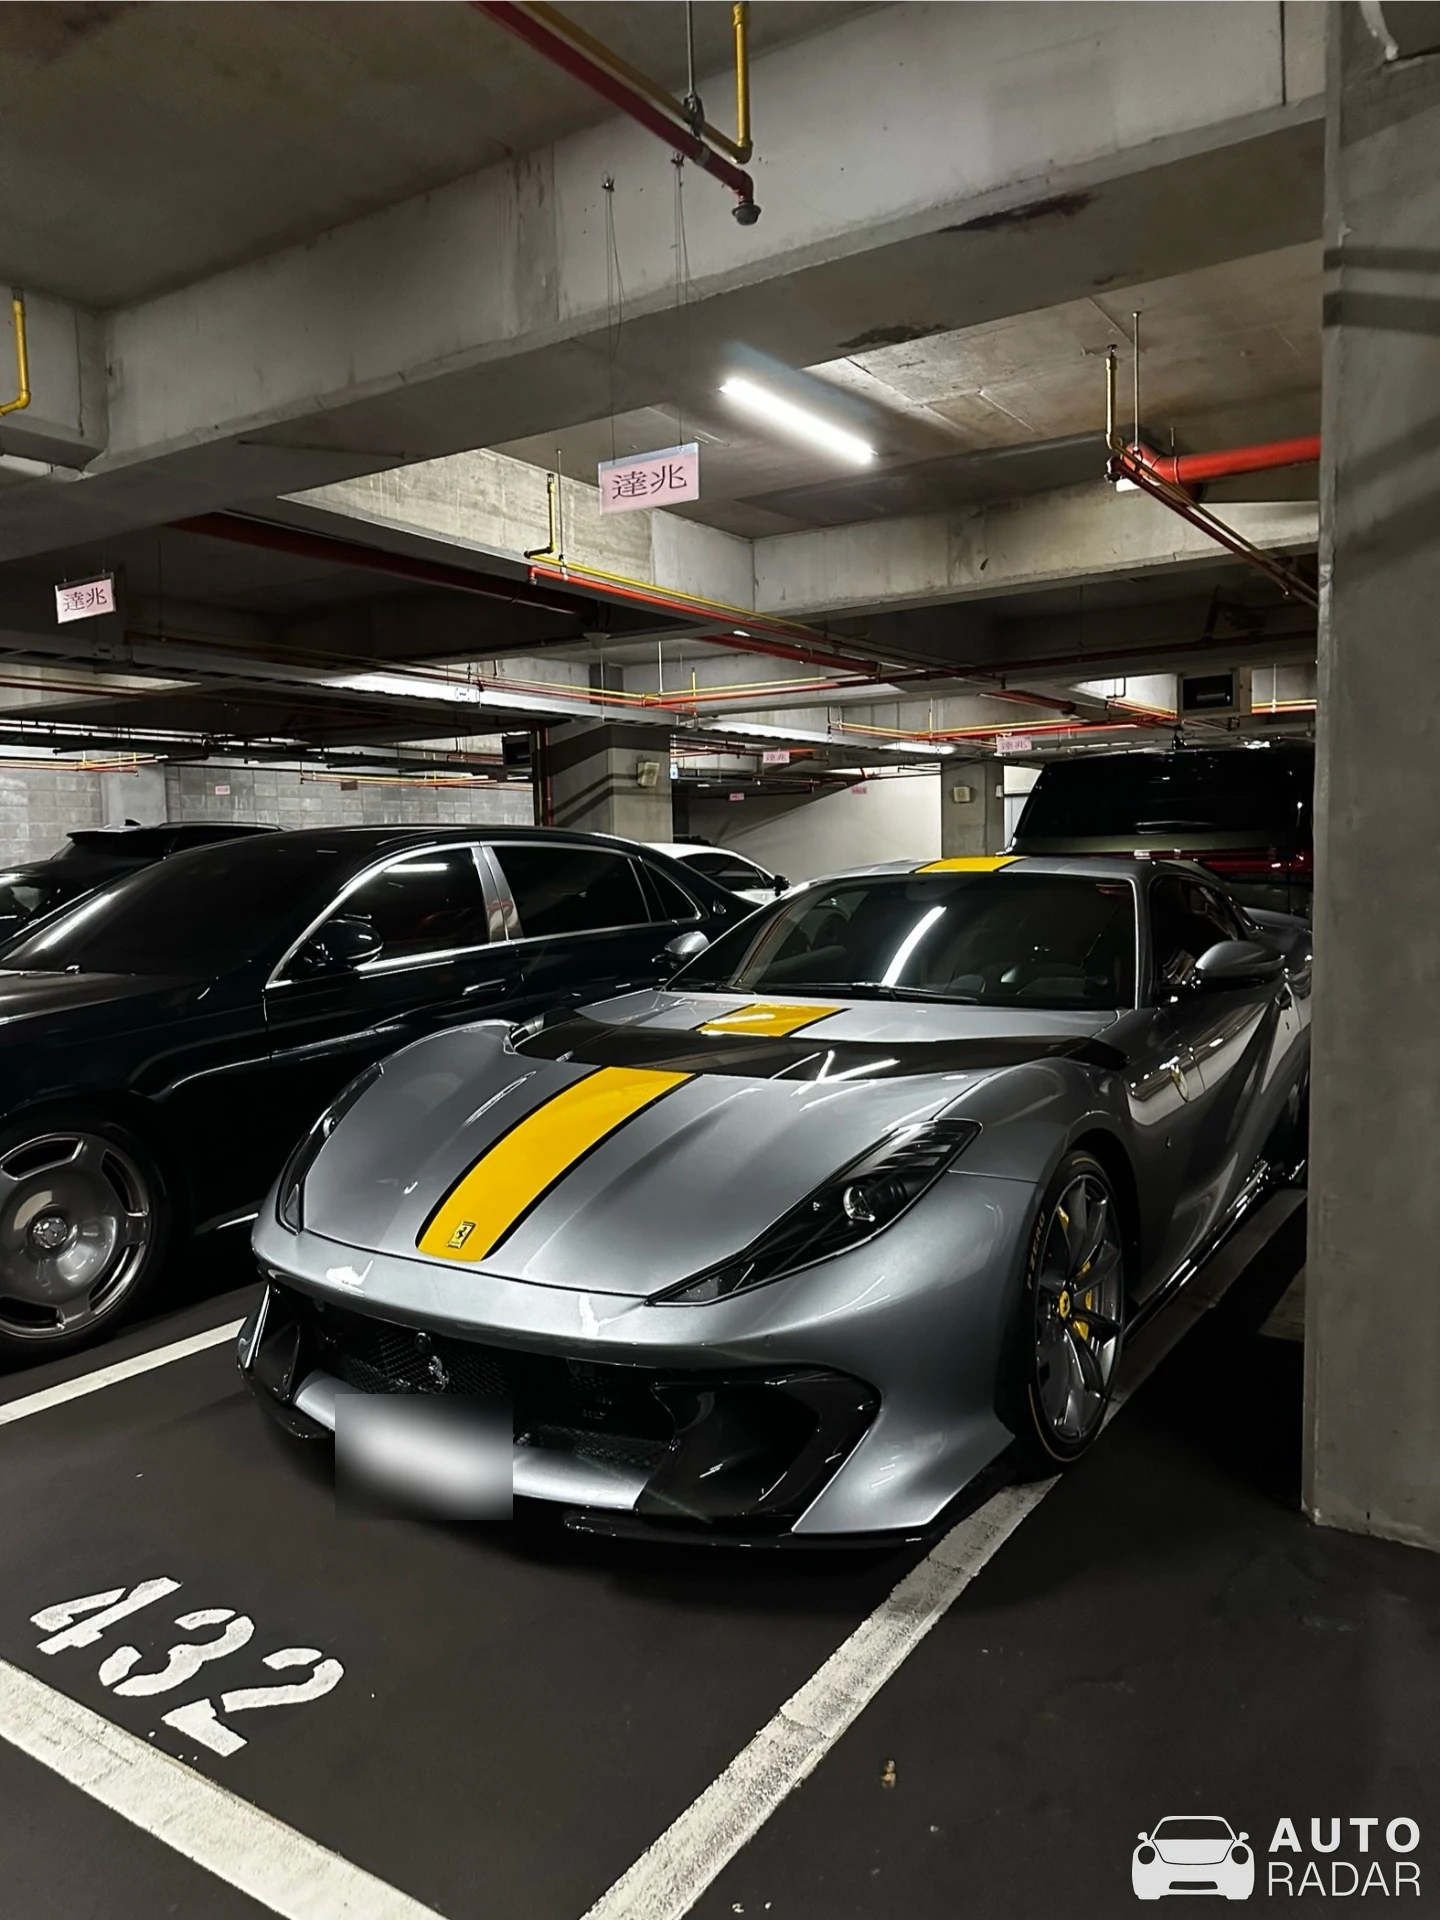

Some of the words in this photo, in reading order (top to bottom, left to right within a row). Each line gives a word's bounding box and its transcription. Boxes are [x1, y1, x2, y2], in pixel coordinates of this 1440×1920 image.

[612, 464, 687, 500] 達兆
[62, 587, 108, 612] 達兆
[30, 1577, 344, 1757] 432
